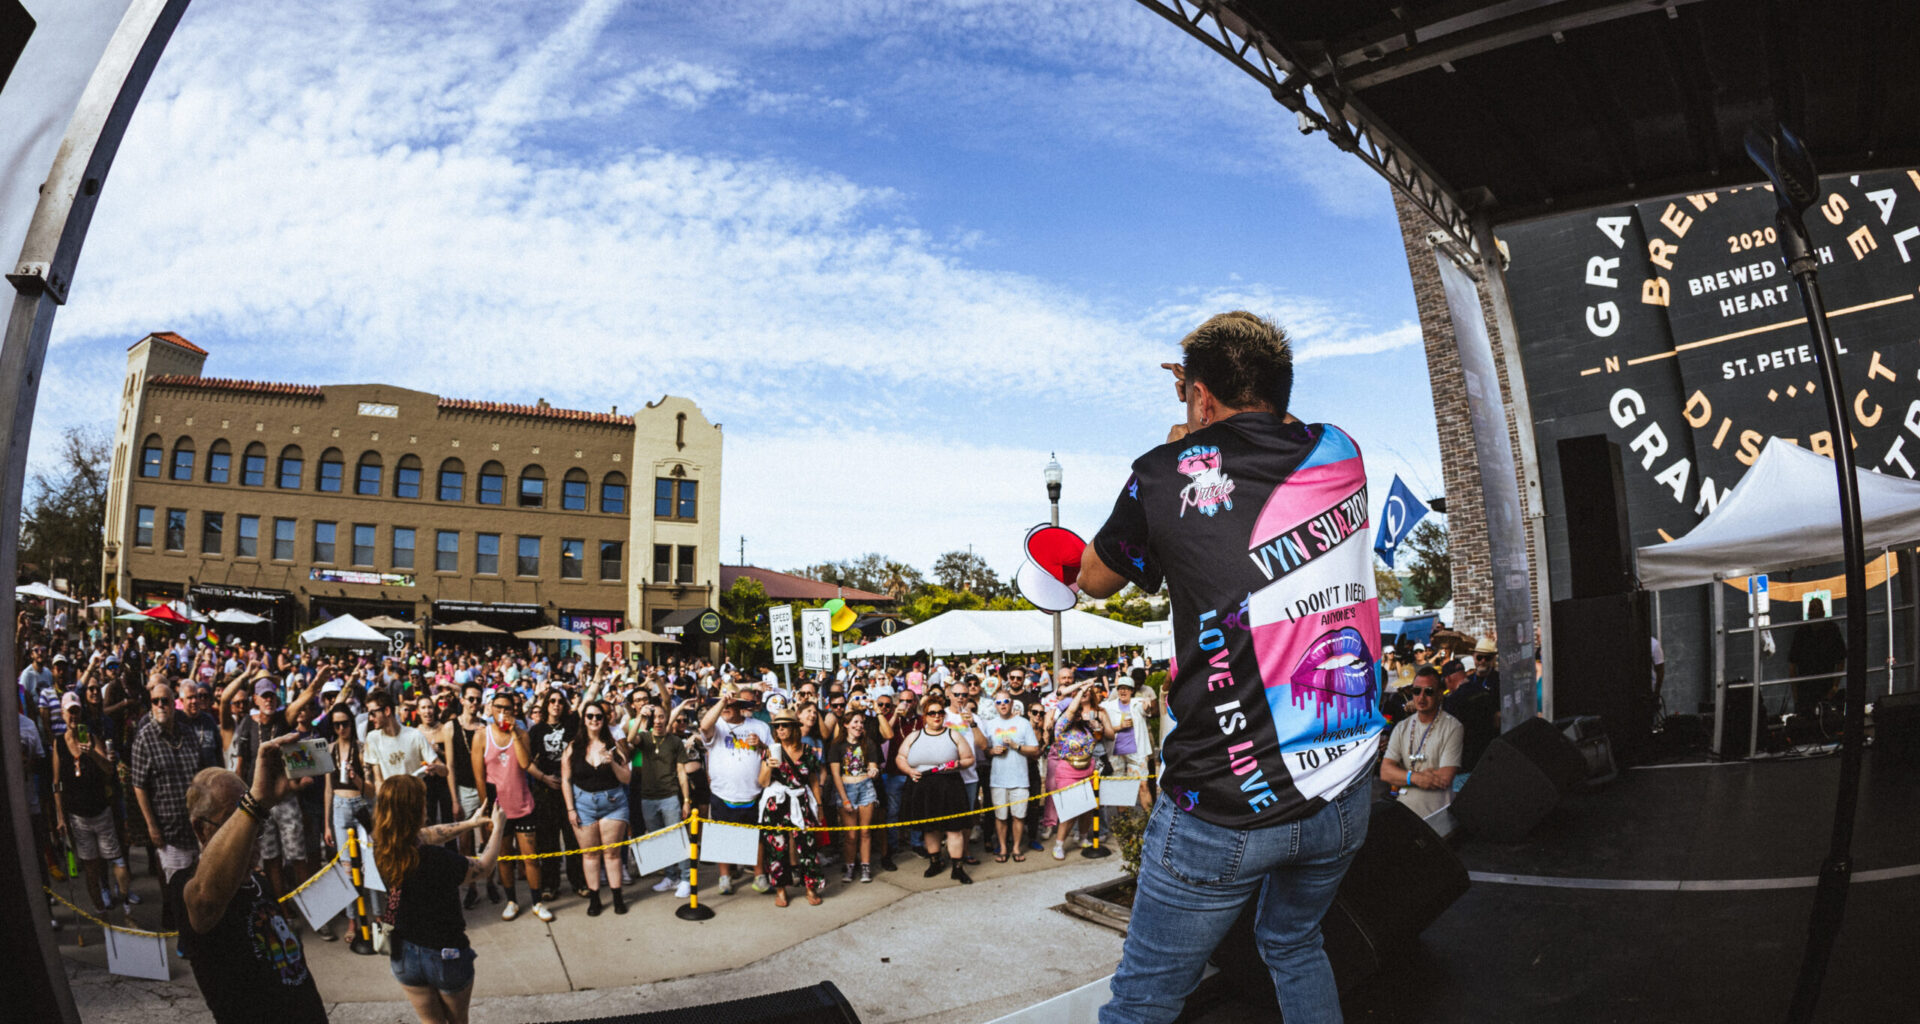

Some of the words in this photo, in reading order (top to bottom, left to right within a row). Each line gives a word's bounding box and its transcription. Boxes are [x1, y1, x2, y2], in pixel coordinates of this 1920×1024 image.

[1727, 226, 1777, 254] 2020
[1584, 216, 1632, 337] GRA
[1688, 260, 1776, 296] BREWED
[1719, 285, 1789, 317] HEART
[1605, 356, 1620, 373] N
[1682, 350, 1897, 466] DISRCT
[1609, 388, 1733, 515] GRAN
[1180, 473, 1236, 518] Pride
[1248, 530, 1312, 581] VYN
[773, 613, 790, 622] SPEED
[1285, 607, 1295, 624] I
[1295, 585, 1340, 618] DON'T
[1345, 582, 1366, 603] NEED
[1320, 607, 1356, 626] ANYONE'S
[573, 621, 609, 630] RAGNG
[775, 624, 789, 634] LIMIT
[775, 636, 793, 656] 25
[1199, 609, 1235, 692] LOVE
[1214, 700, 1247, 735] IS
[1313, 722, 1368, 743] APPROVAL
[1296, 749, 1320, 770] TO
[1227, 740, 1278, 814] LOVE
